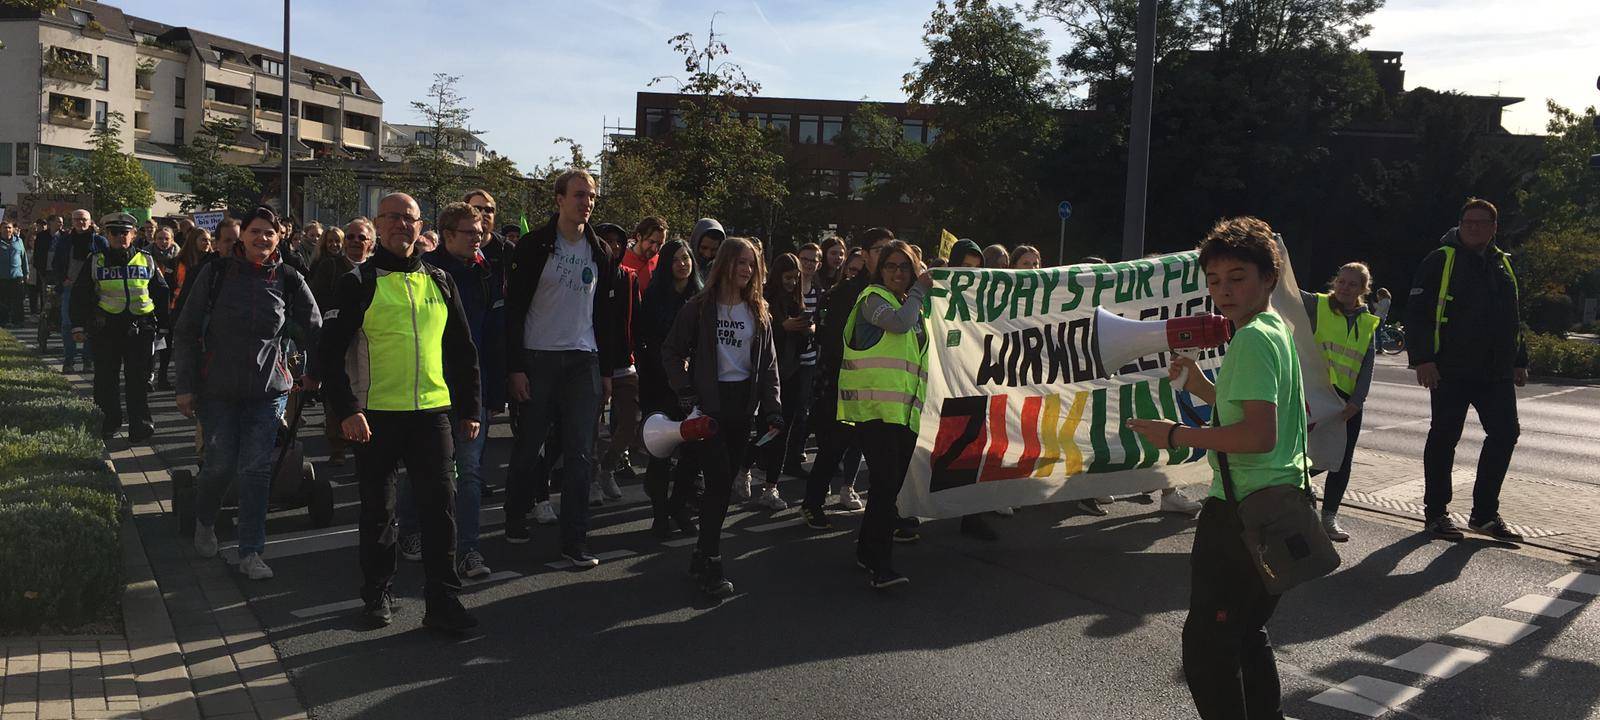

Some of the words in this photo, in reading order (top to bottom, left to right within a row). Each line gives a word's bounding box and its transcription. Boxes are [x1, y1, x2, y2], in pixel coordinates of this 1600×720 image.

[103, 266, 148, 280] POLIZEI
[922, 266, 1086, 323] FRIDAYS
[1090, 261, 1155, 308] FOR
[715, 320, 745, 330] RIDAYS
[718, 330, 735, 339] FOR
[717, 337, 743, 348] TURE
